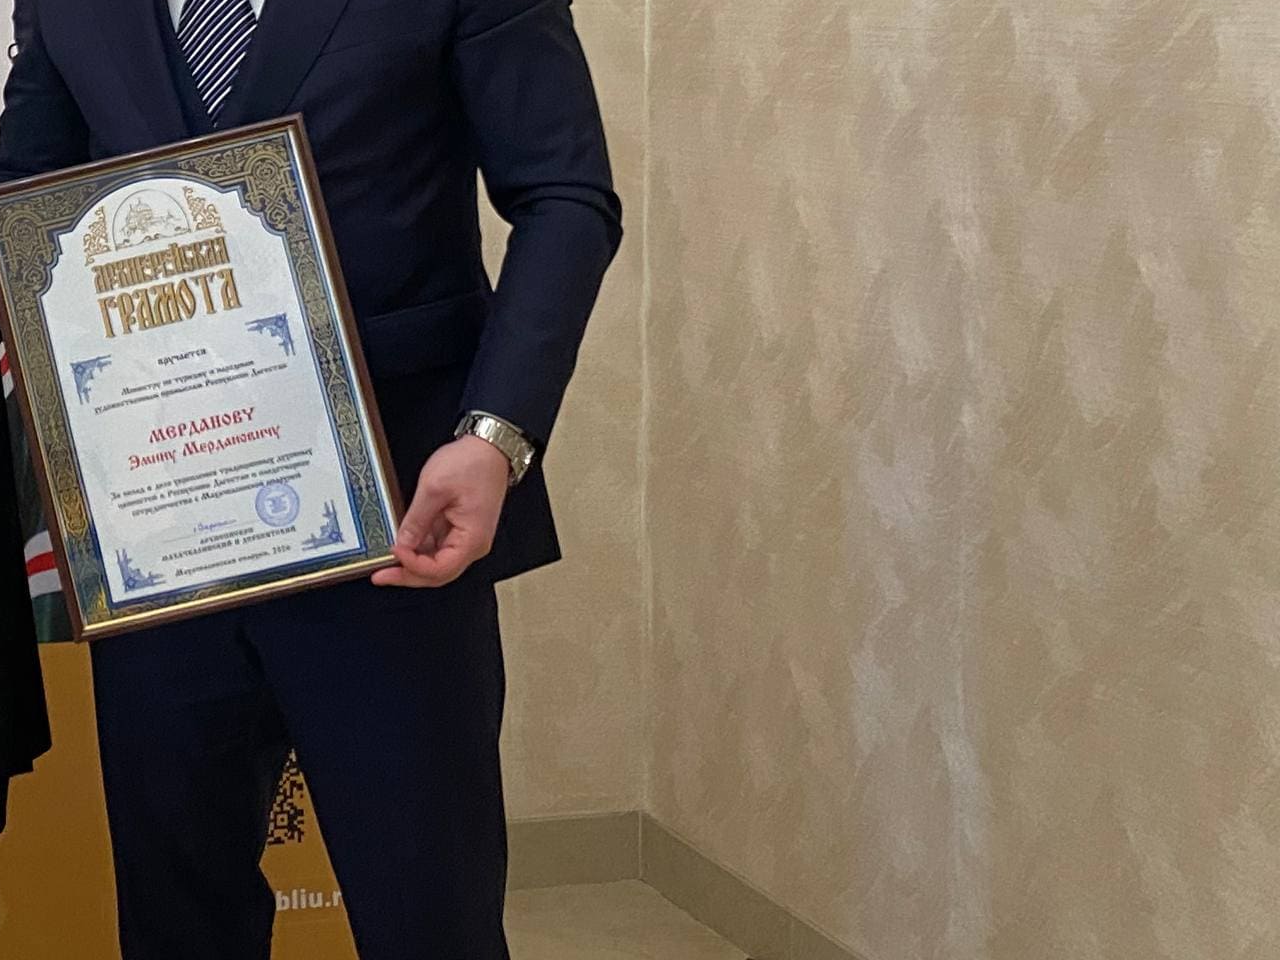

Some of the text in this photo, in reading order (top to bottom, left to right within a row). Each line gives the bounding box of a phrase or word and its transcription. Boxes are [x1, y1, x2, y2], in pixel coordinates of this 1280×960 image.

[98, 268, 242, 338] ГРАМОТА
[128, 425, 280, 471] Эмину Мердановичу
[149, 407, 256, 443] МЕРДАНОВУ
